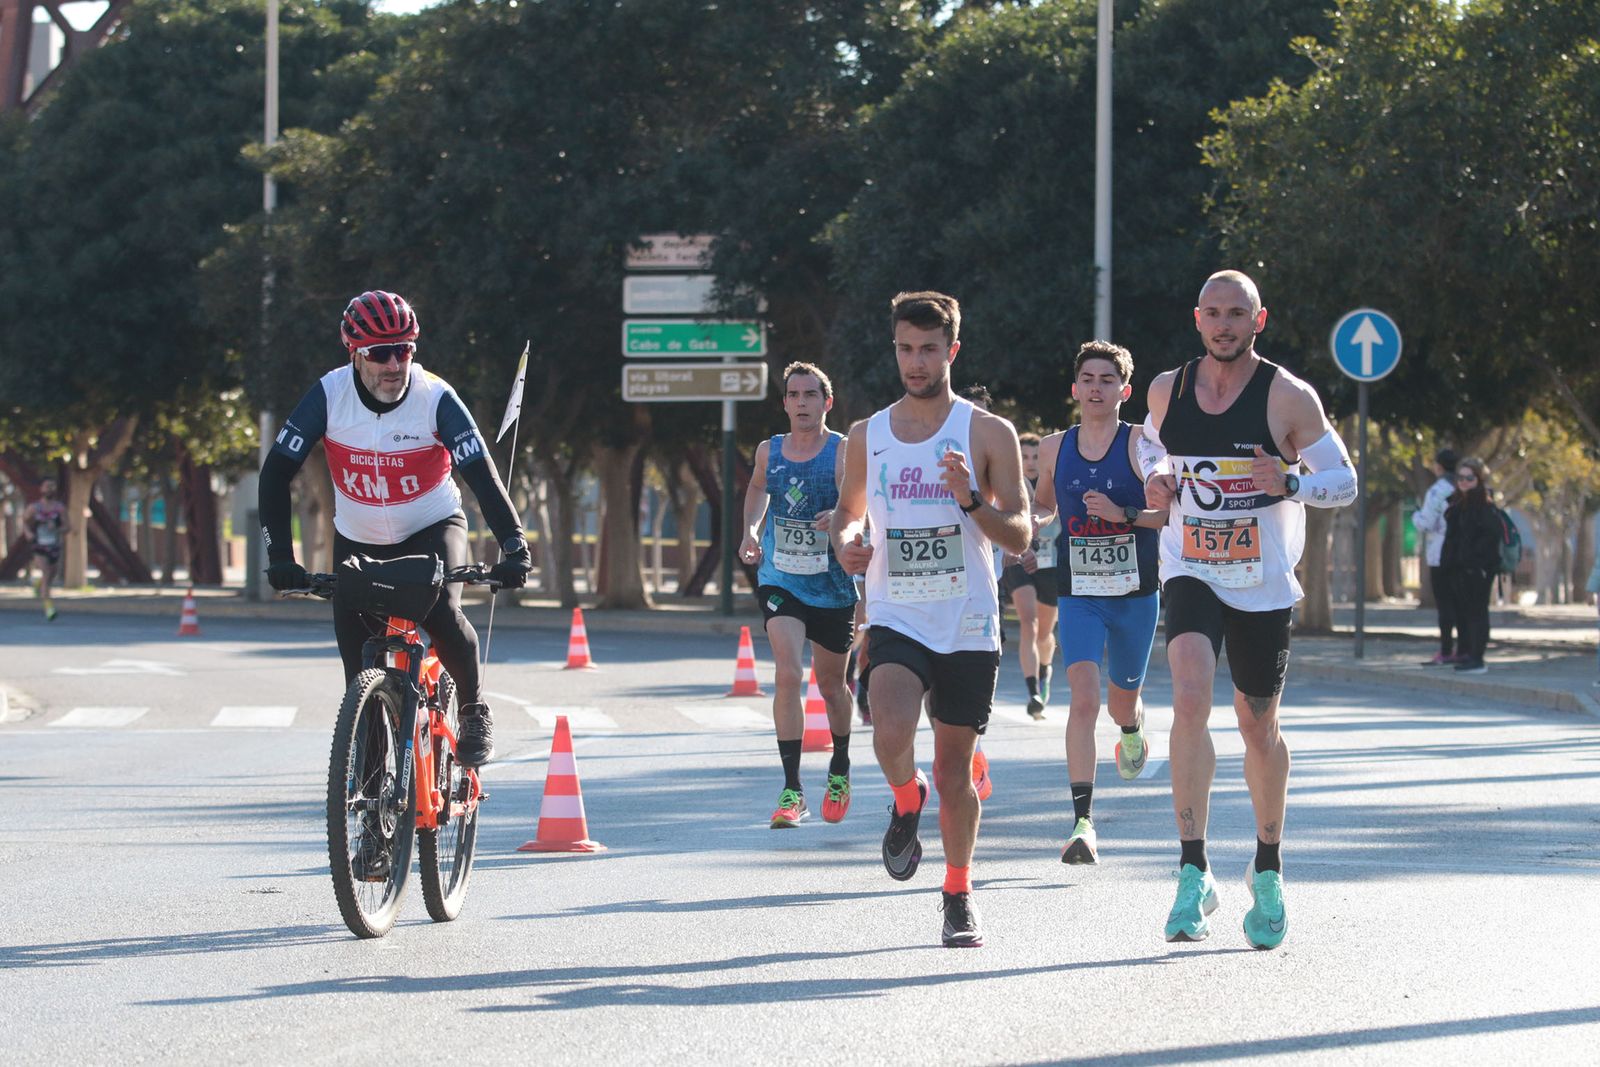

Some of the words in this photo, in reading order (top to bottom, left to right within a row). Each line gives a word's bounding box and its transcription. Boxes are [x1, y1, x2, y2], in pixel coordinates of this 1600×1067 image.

[629, 340, 660, 350] Cabo
[667, 340, 682, 350] de
[688, 339, 718, 350] Gata
[629, 383, 670, 394] playas
[350, 454, 404, 467] BICICLETAS
[452, 437, 480, 466] KM
[342, 467, 390, 499] KM
[1228, 499, 1256, 508] SPORT
[783, 528, 816, 546] 793
[1191, 528, 1252, 550] 1574
[900, 539, 948, 561] 926
[1078, 545, 1129, 565] 1430
